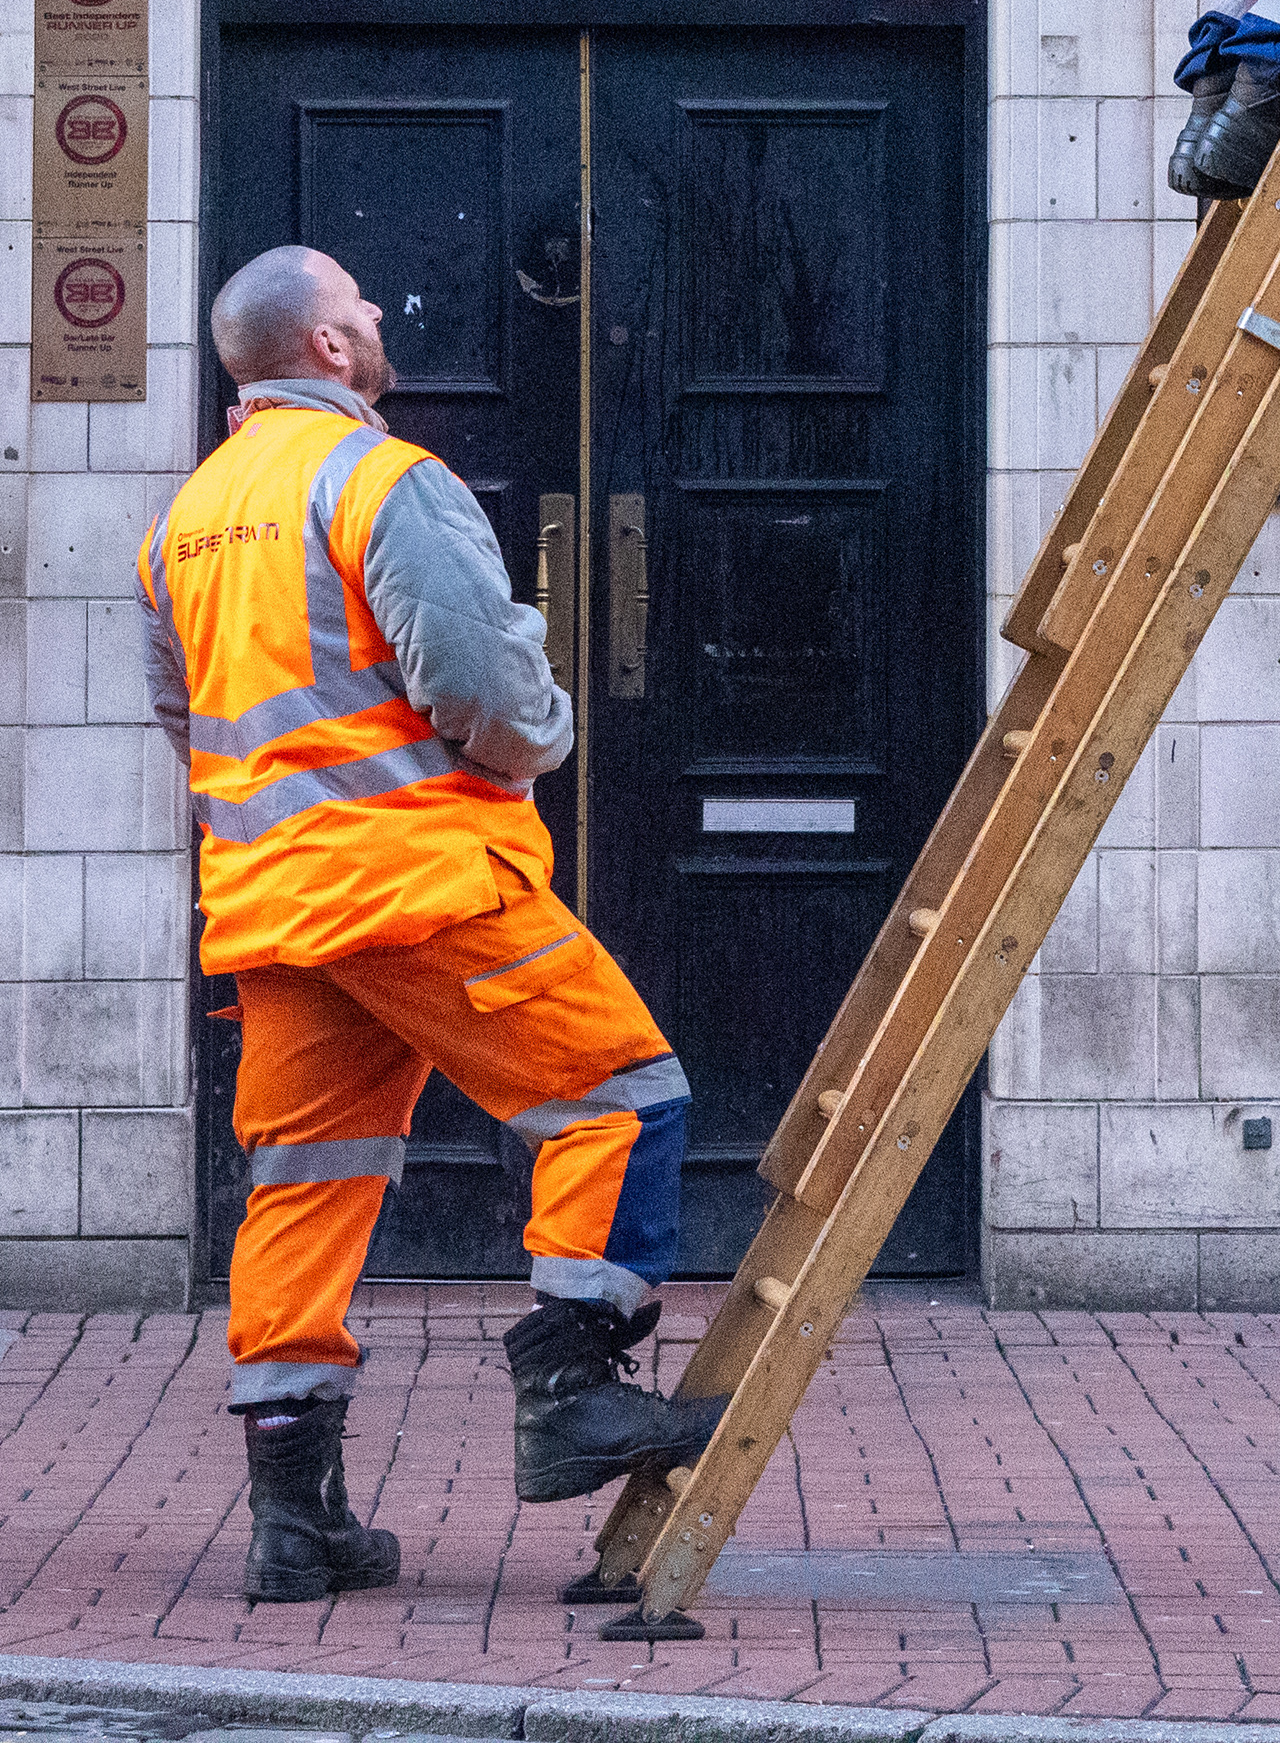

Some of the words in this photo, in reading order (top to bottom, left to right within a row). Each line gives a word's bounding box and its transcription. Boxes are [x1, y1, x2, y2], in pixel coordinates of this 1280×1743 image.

[73, 12, 140, 21] Independent
[47, 21, 112, 30] RUNNER
[116, 21, 137, 30] UP
[64, 171, 117, 179] Independent
